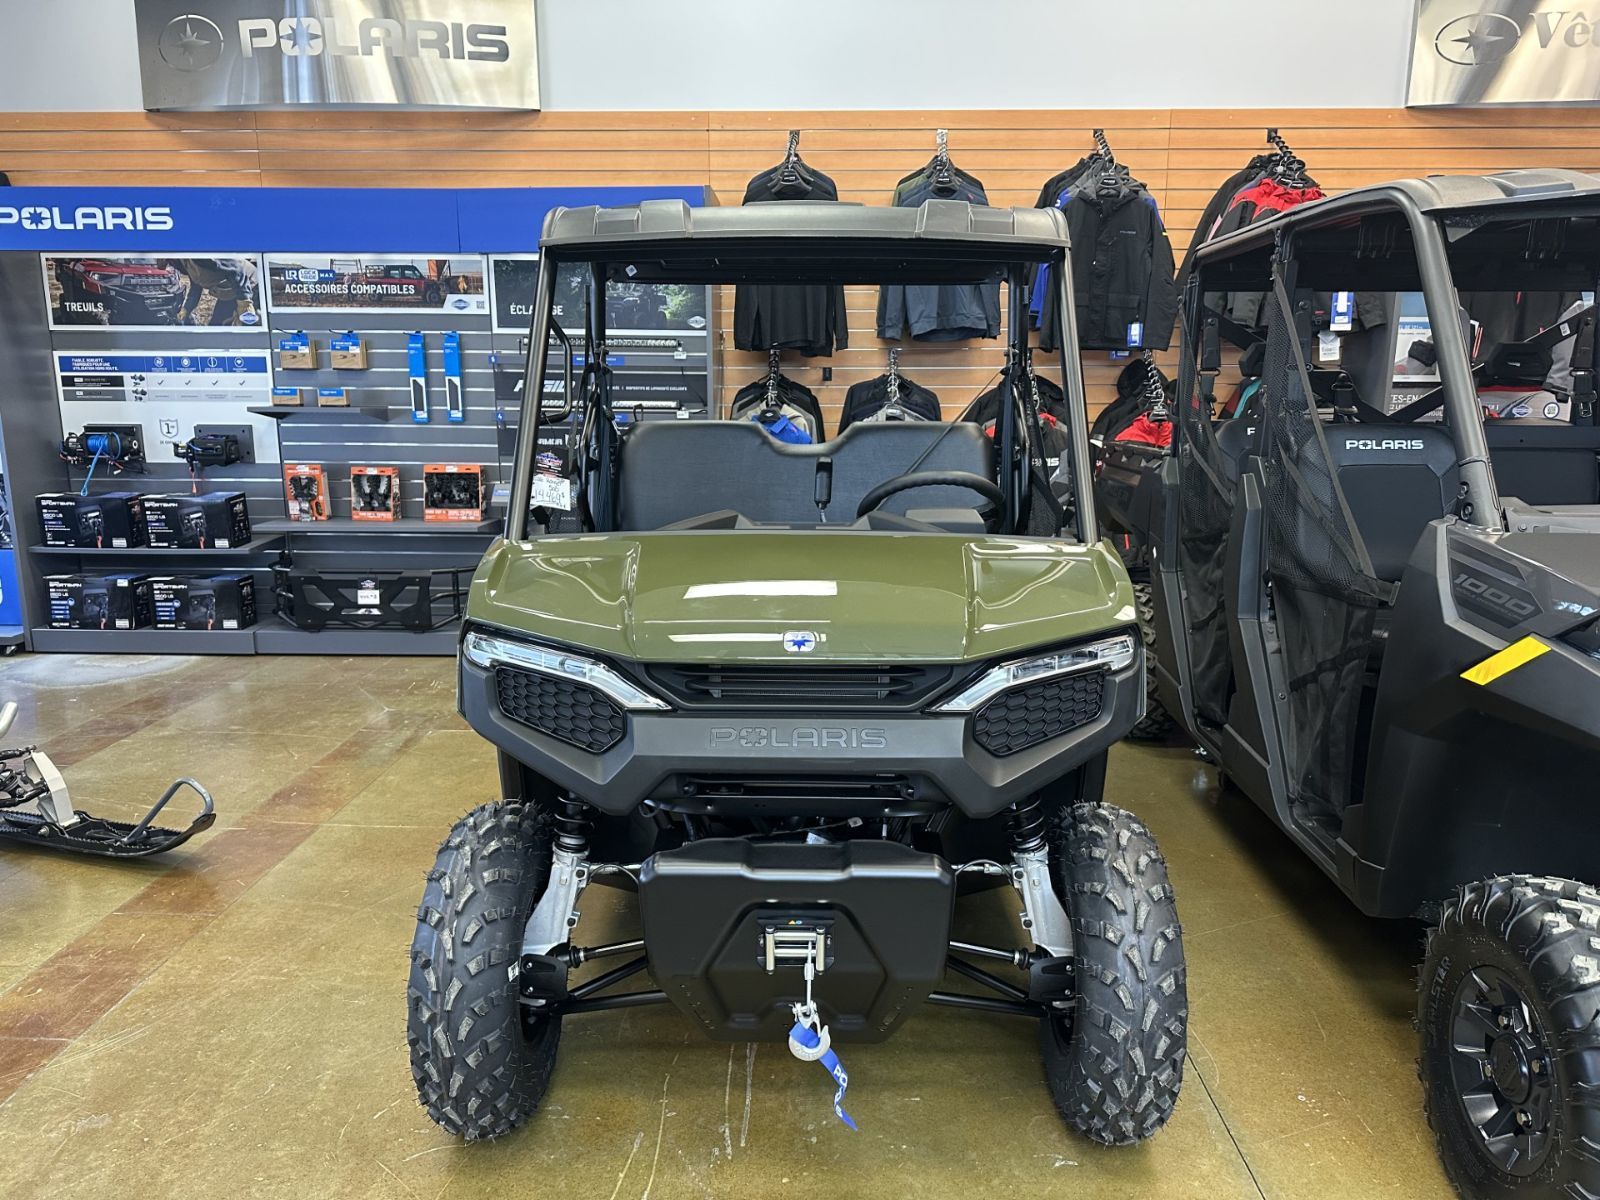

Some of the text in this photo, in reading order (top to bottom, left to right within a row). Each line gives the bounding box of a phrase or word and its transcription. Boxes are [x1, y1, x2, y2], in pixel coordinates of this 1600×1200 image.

[238, 17, 509, 62] POLARIS
[0, 207, 174, 231] POLARIS
[285, 284, 415, 295] ACCESSOIRES COMPATIBLES
[64, 302, 104, 312] TREUILS
[1345, 439, 1424, 450] POLARIS
[1454, 573, 1536, 616] 1000
[710, 727, 888, 748] POLARIS
